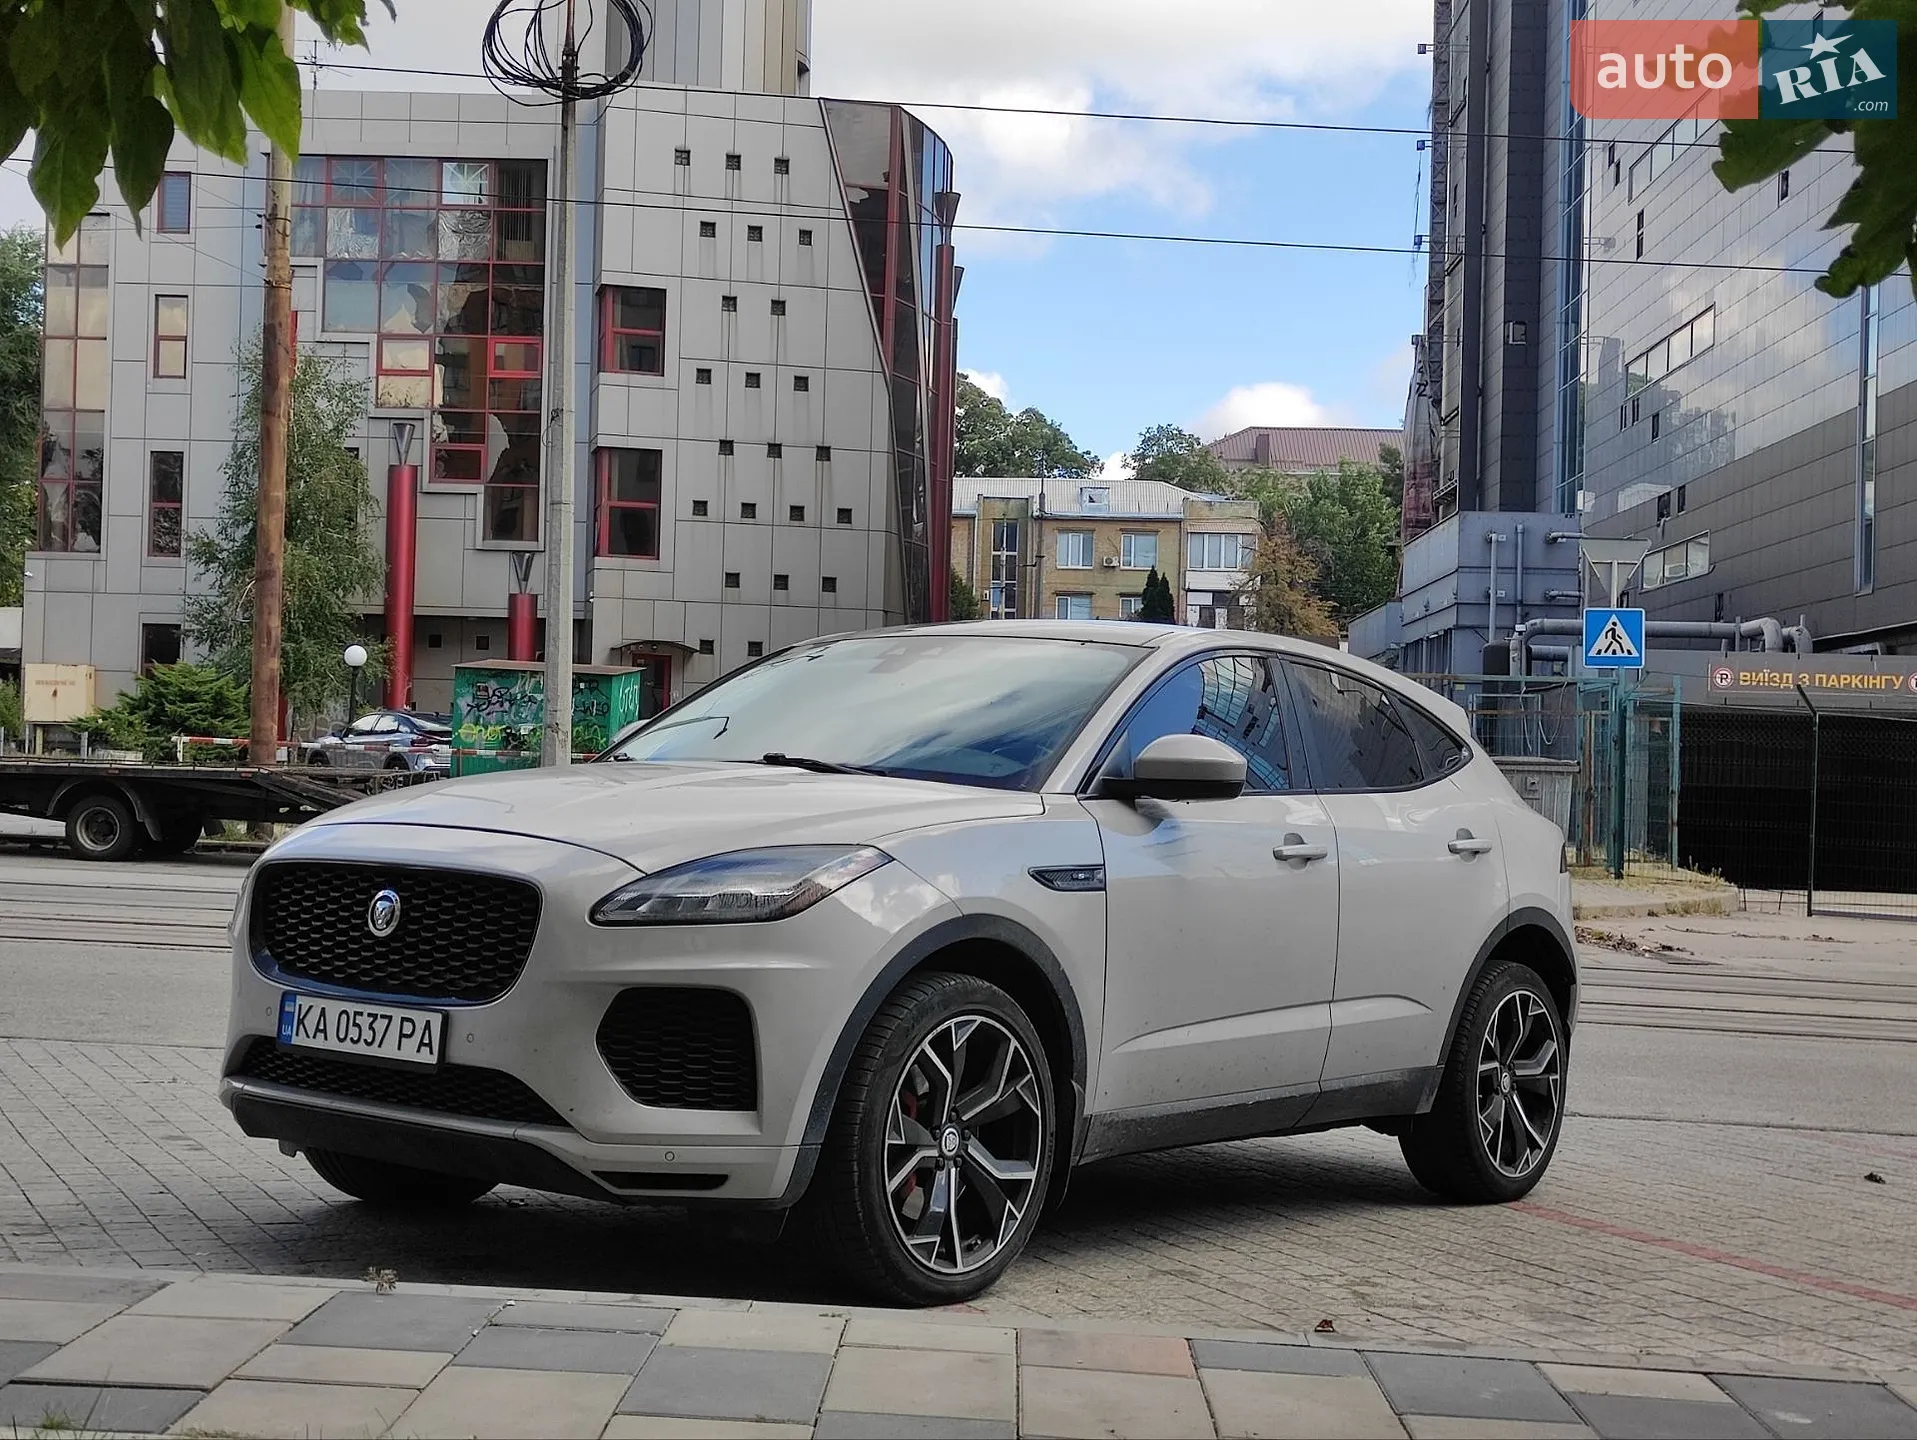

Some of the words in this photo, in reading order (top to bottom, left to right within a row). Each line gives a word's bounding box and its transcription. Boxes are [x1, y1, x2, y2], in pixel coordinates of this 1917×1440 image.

[1739, 669, 1794, 689] ВИЇЗД
[1815, 674, 1904, 690] ПАРКІНГУ
[281, 1024, 292, 1036] UA
[295, 1003, 328, 1041] KA
[336, 1009, 393, 1049] 0537
[397, 1016, 434, 1055] PA
